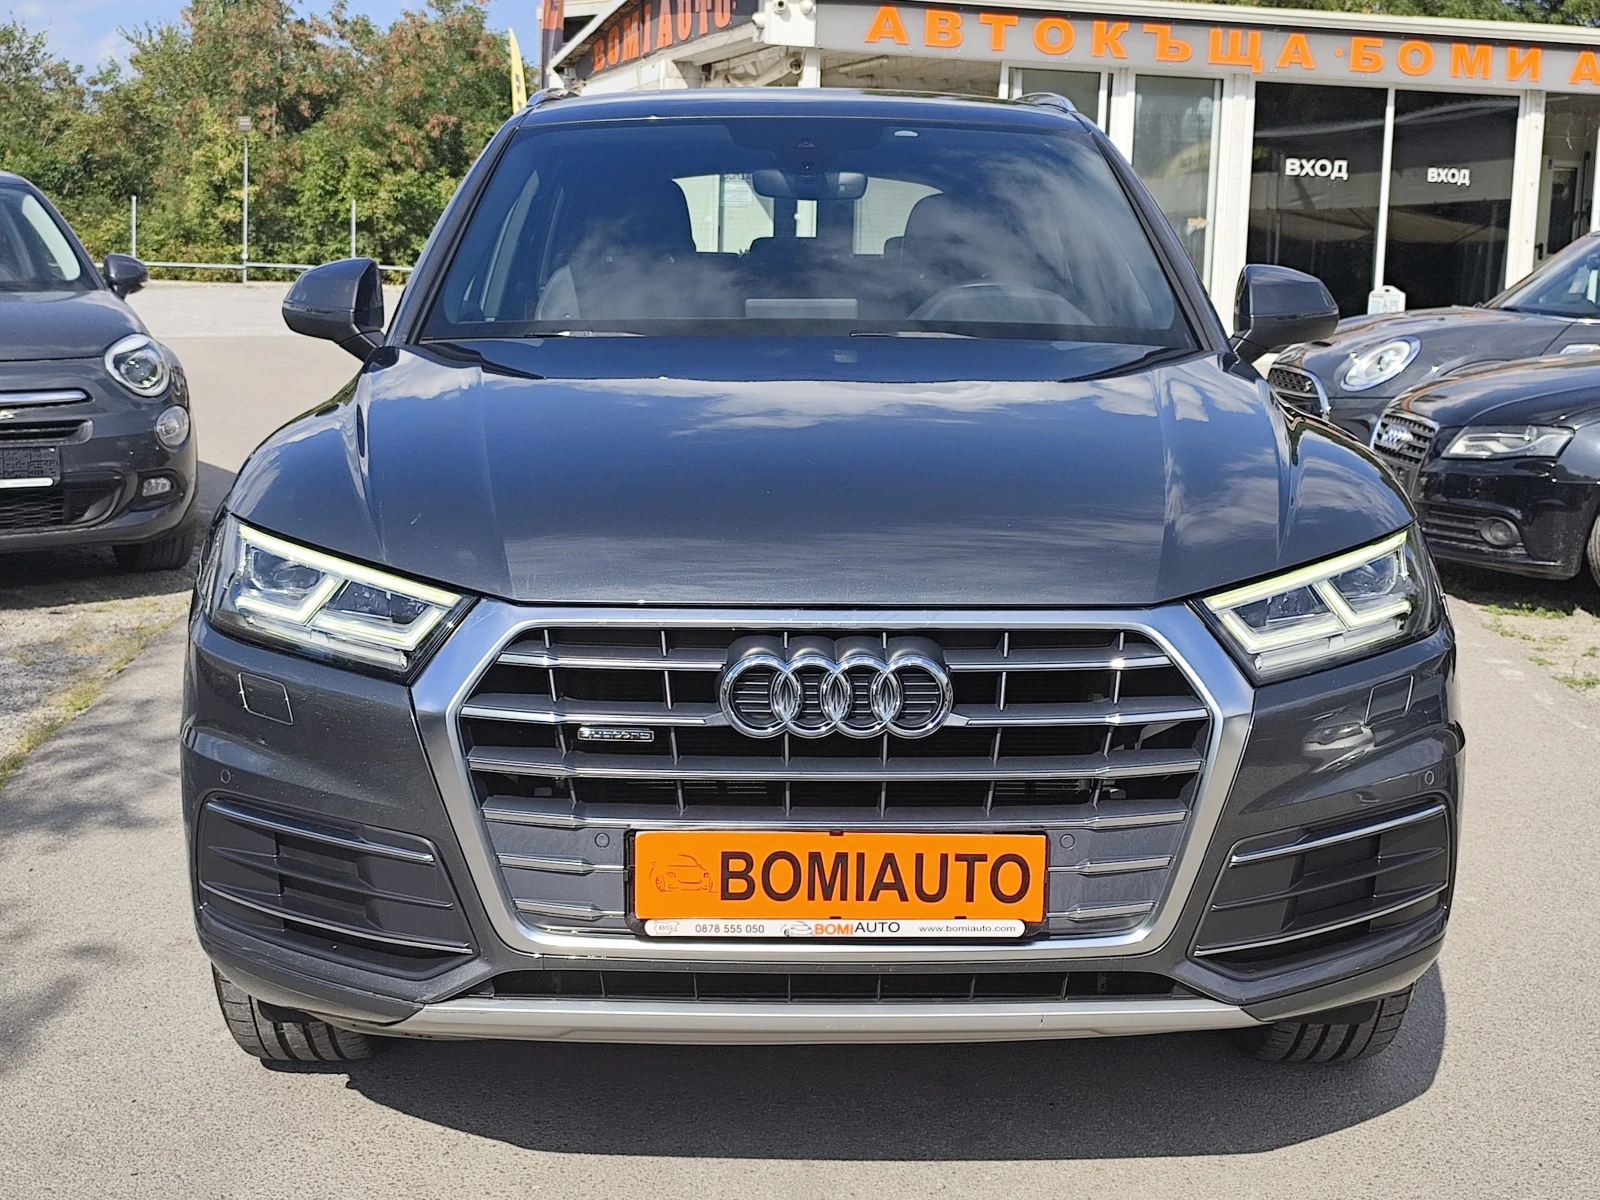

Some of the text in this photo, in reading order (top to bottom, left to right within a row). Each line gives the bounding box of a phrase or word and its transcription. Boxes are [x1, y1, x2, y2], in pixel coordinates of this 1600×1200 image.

[864, 5, 1316, 73] АВТОКЪЩА
[1349, 35, 1542, 82] БОМИ
[1285, 158, 1349, 181] ВХОД
[1427, 167, 1471, 187] ВХОД
[719, 851, 1031, 904] BOMIAUTO
[695, 924, 720, 934] 0878
[723, 924, 743, 934] 555
[745, 924, 765, 934] 050
[814, 921, 900, 936] BOMIAUTO
[919, 924, 1016, 933] www.bomiauto.com
